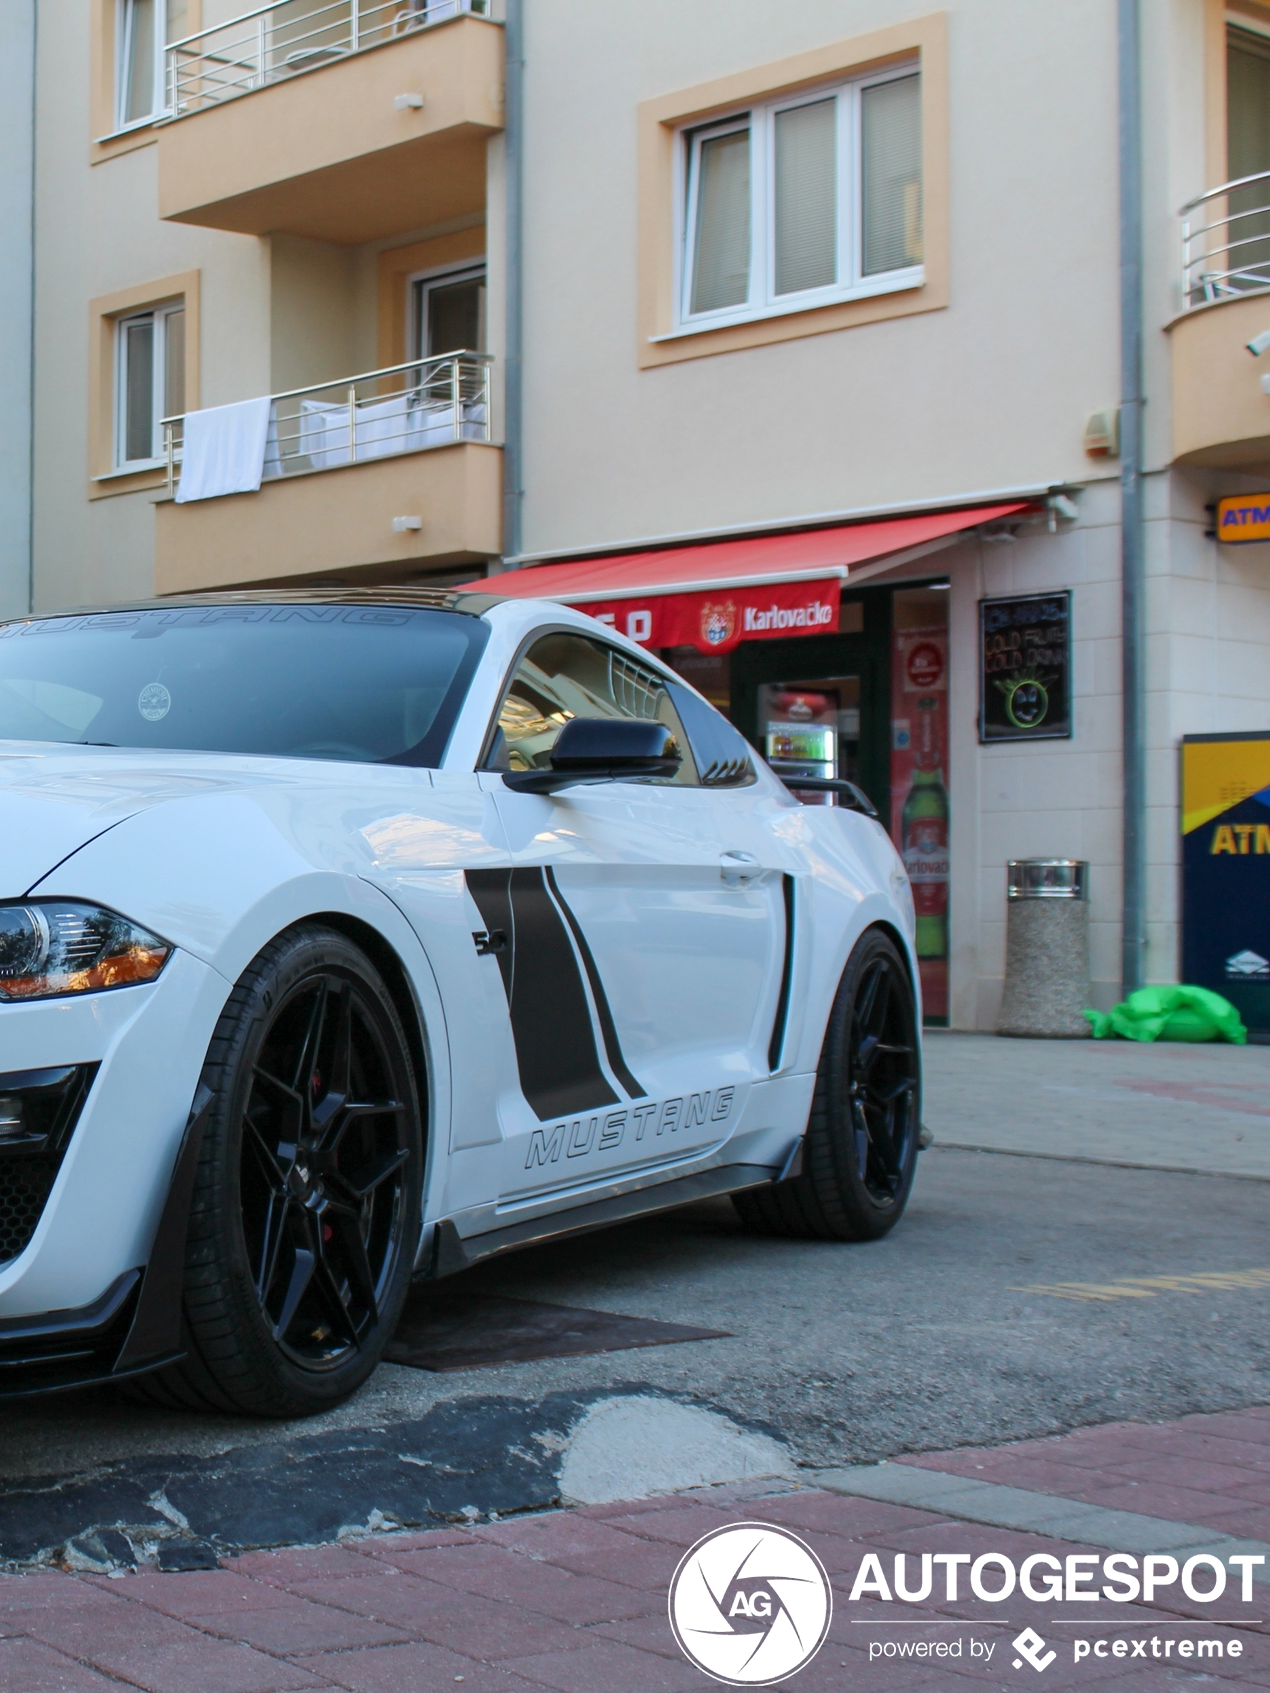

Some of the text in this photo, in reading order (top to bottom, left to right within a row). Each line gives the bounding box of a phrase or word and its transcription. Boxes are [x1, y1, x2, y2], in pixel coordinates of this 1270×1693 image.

[1223, 506, 1270, 527] ATM
[744, 601, 832, 632] Karlovačko
[524, 1085, 735, 1170] MUSTANG
